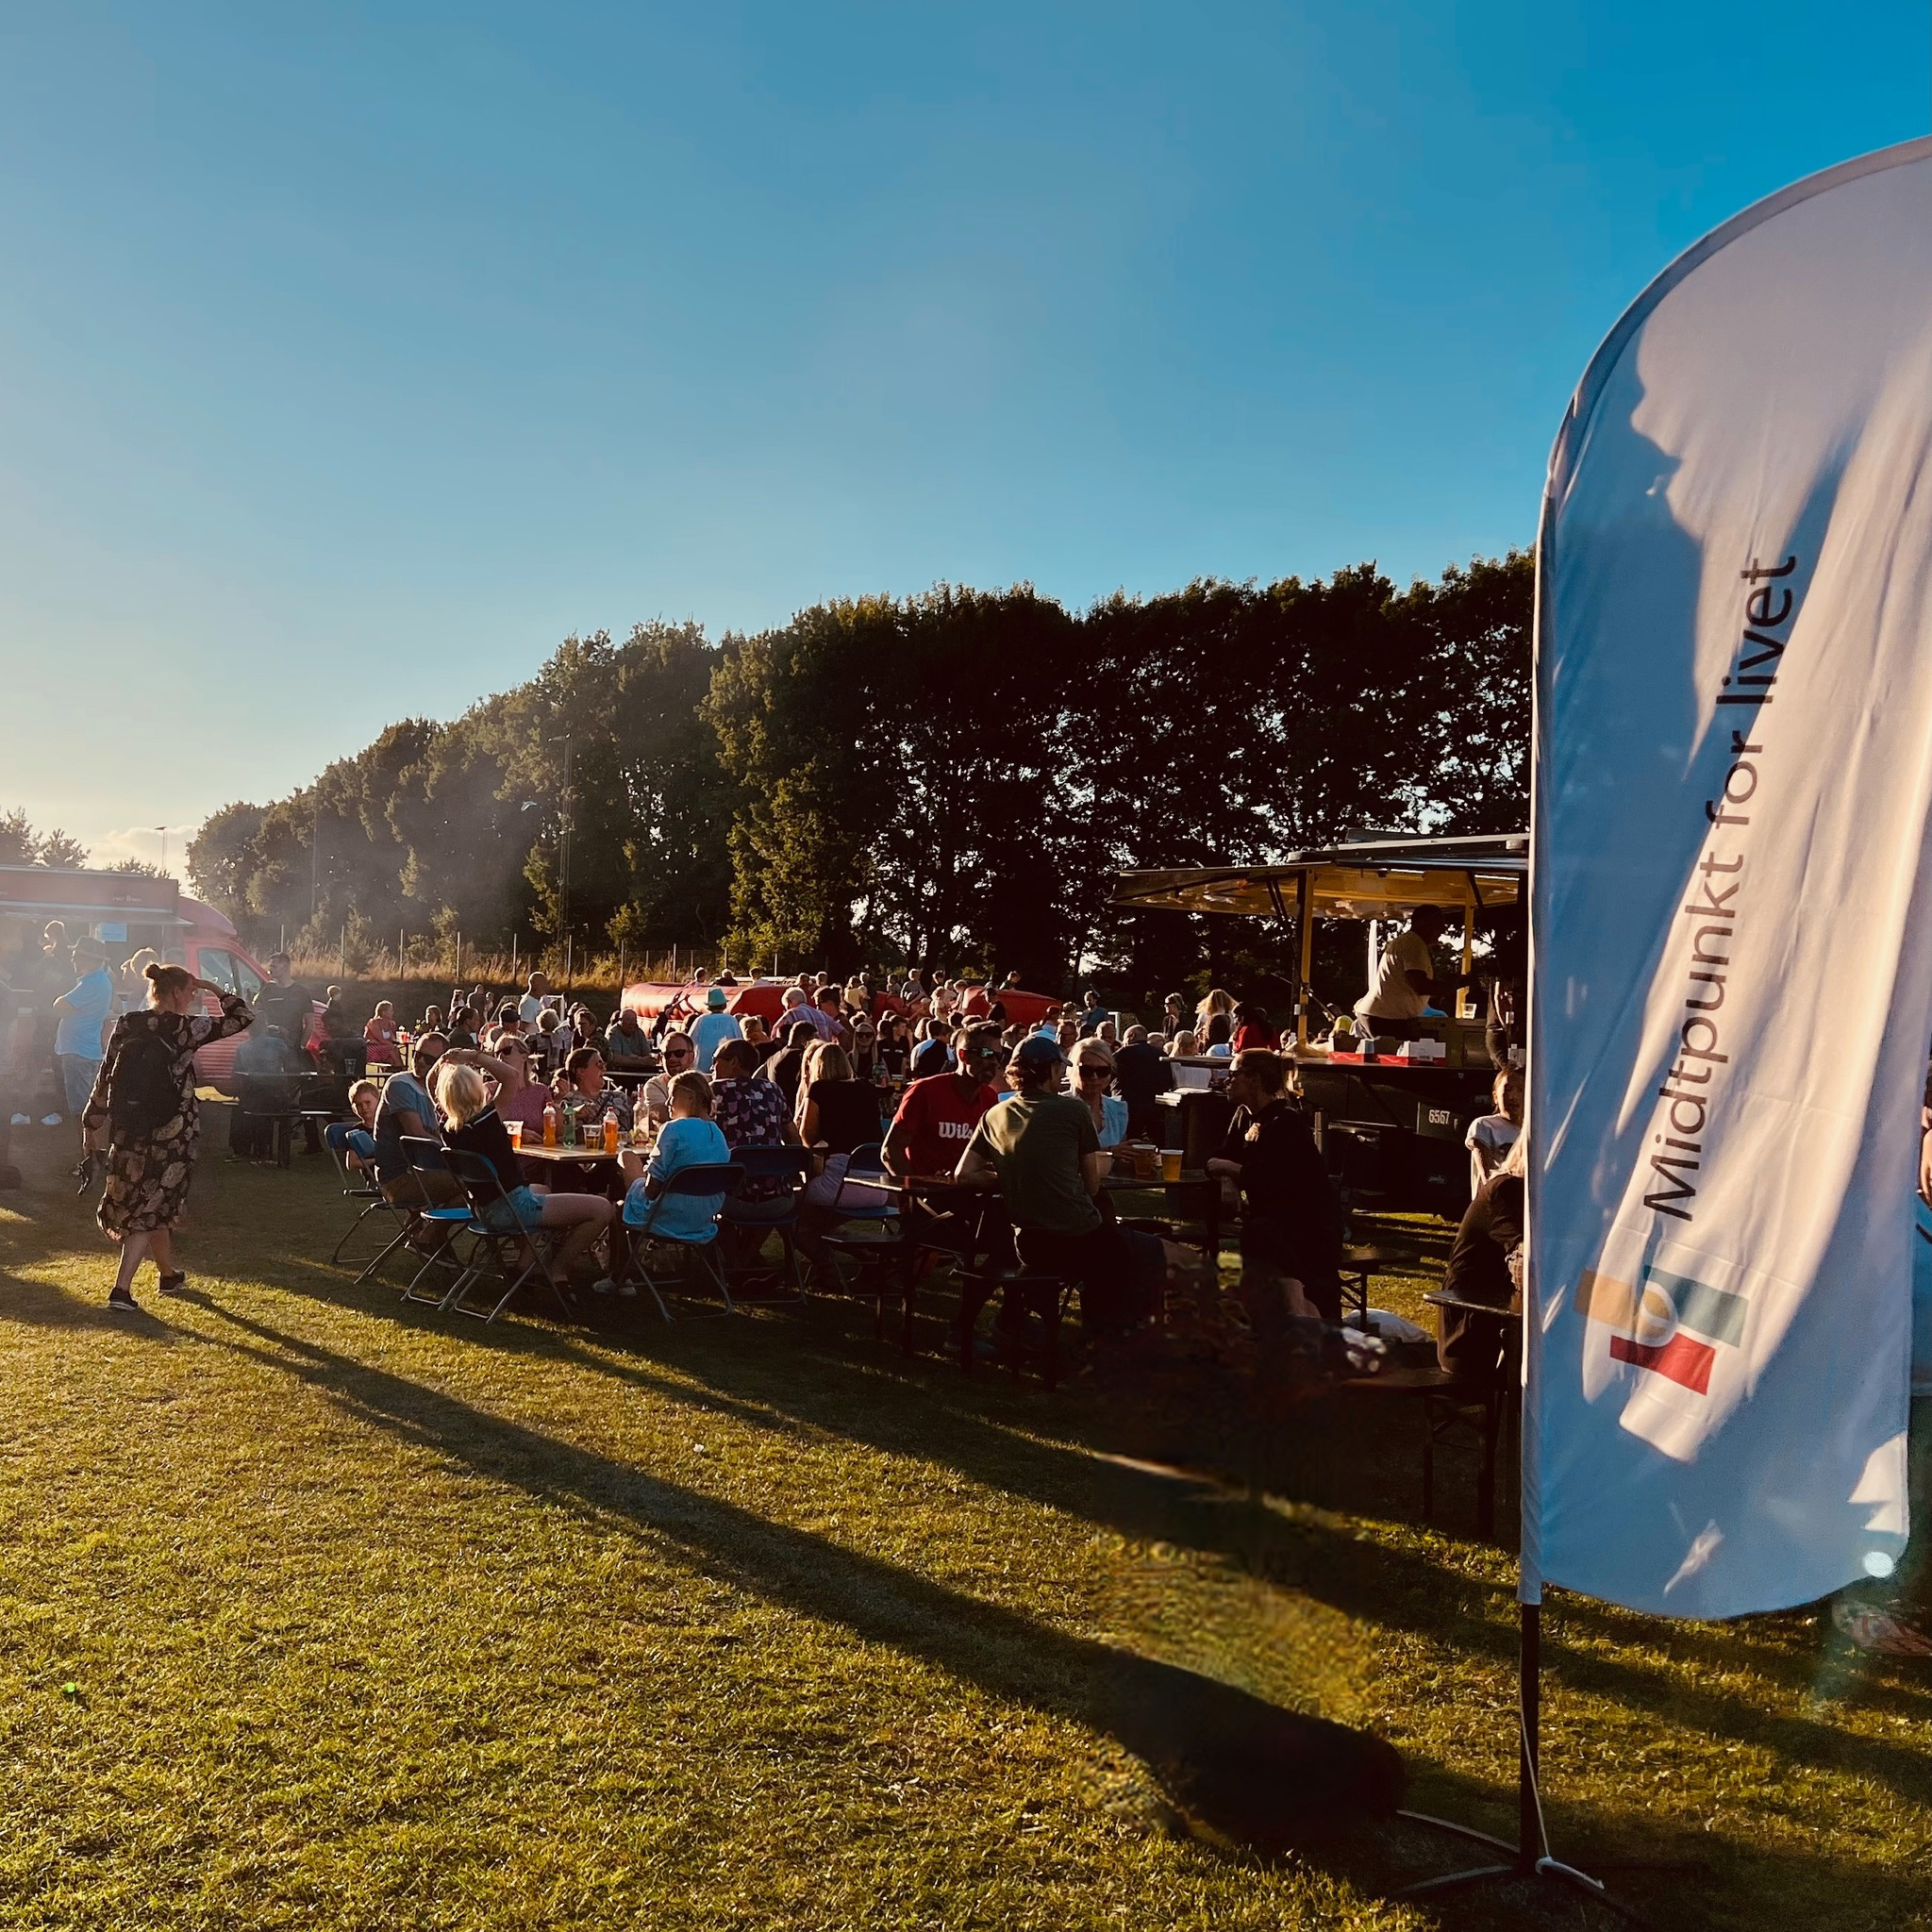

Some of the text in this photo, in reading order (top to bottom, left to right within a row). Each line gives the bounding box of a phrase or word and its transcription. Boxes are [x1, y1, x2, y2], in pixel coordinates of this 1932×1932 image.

[1643, 555, 1797, 1222] Midtpunkt for livet
[1428, 1109, 1450, 1124] 6567
